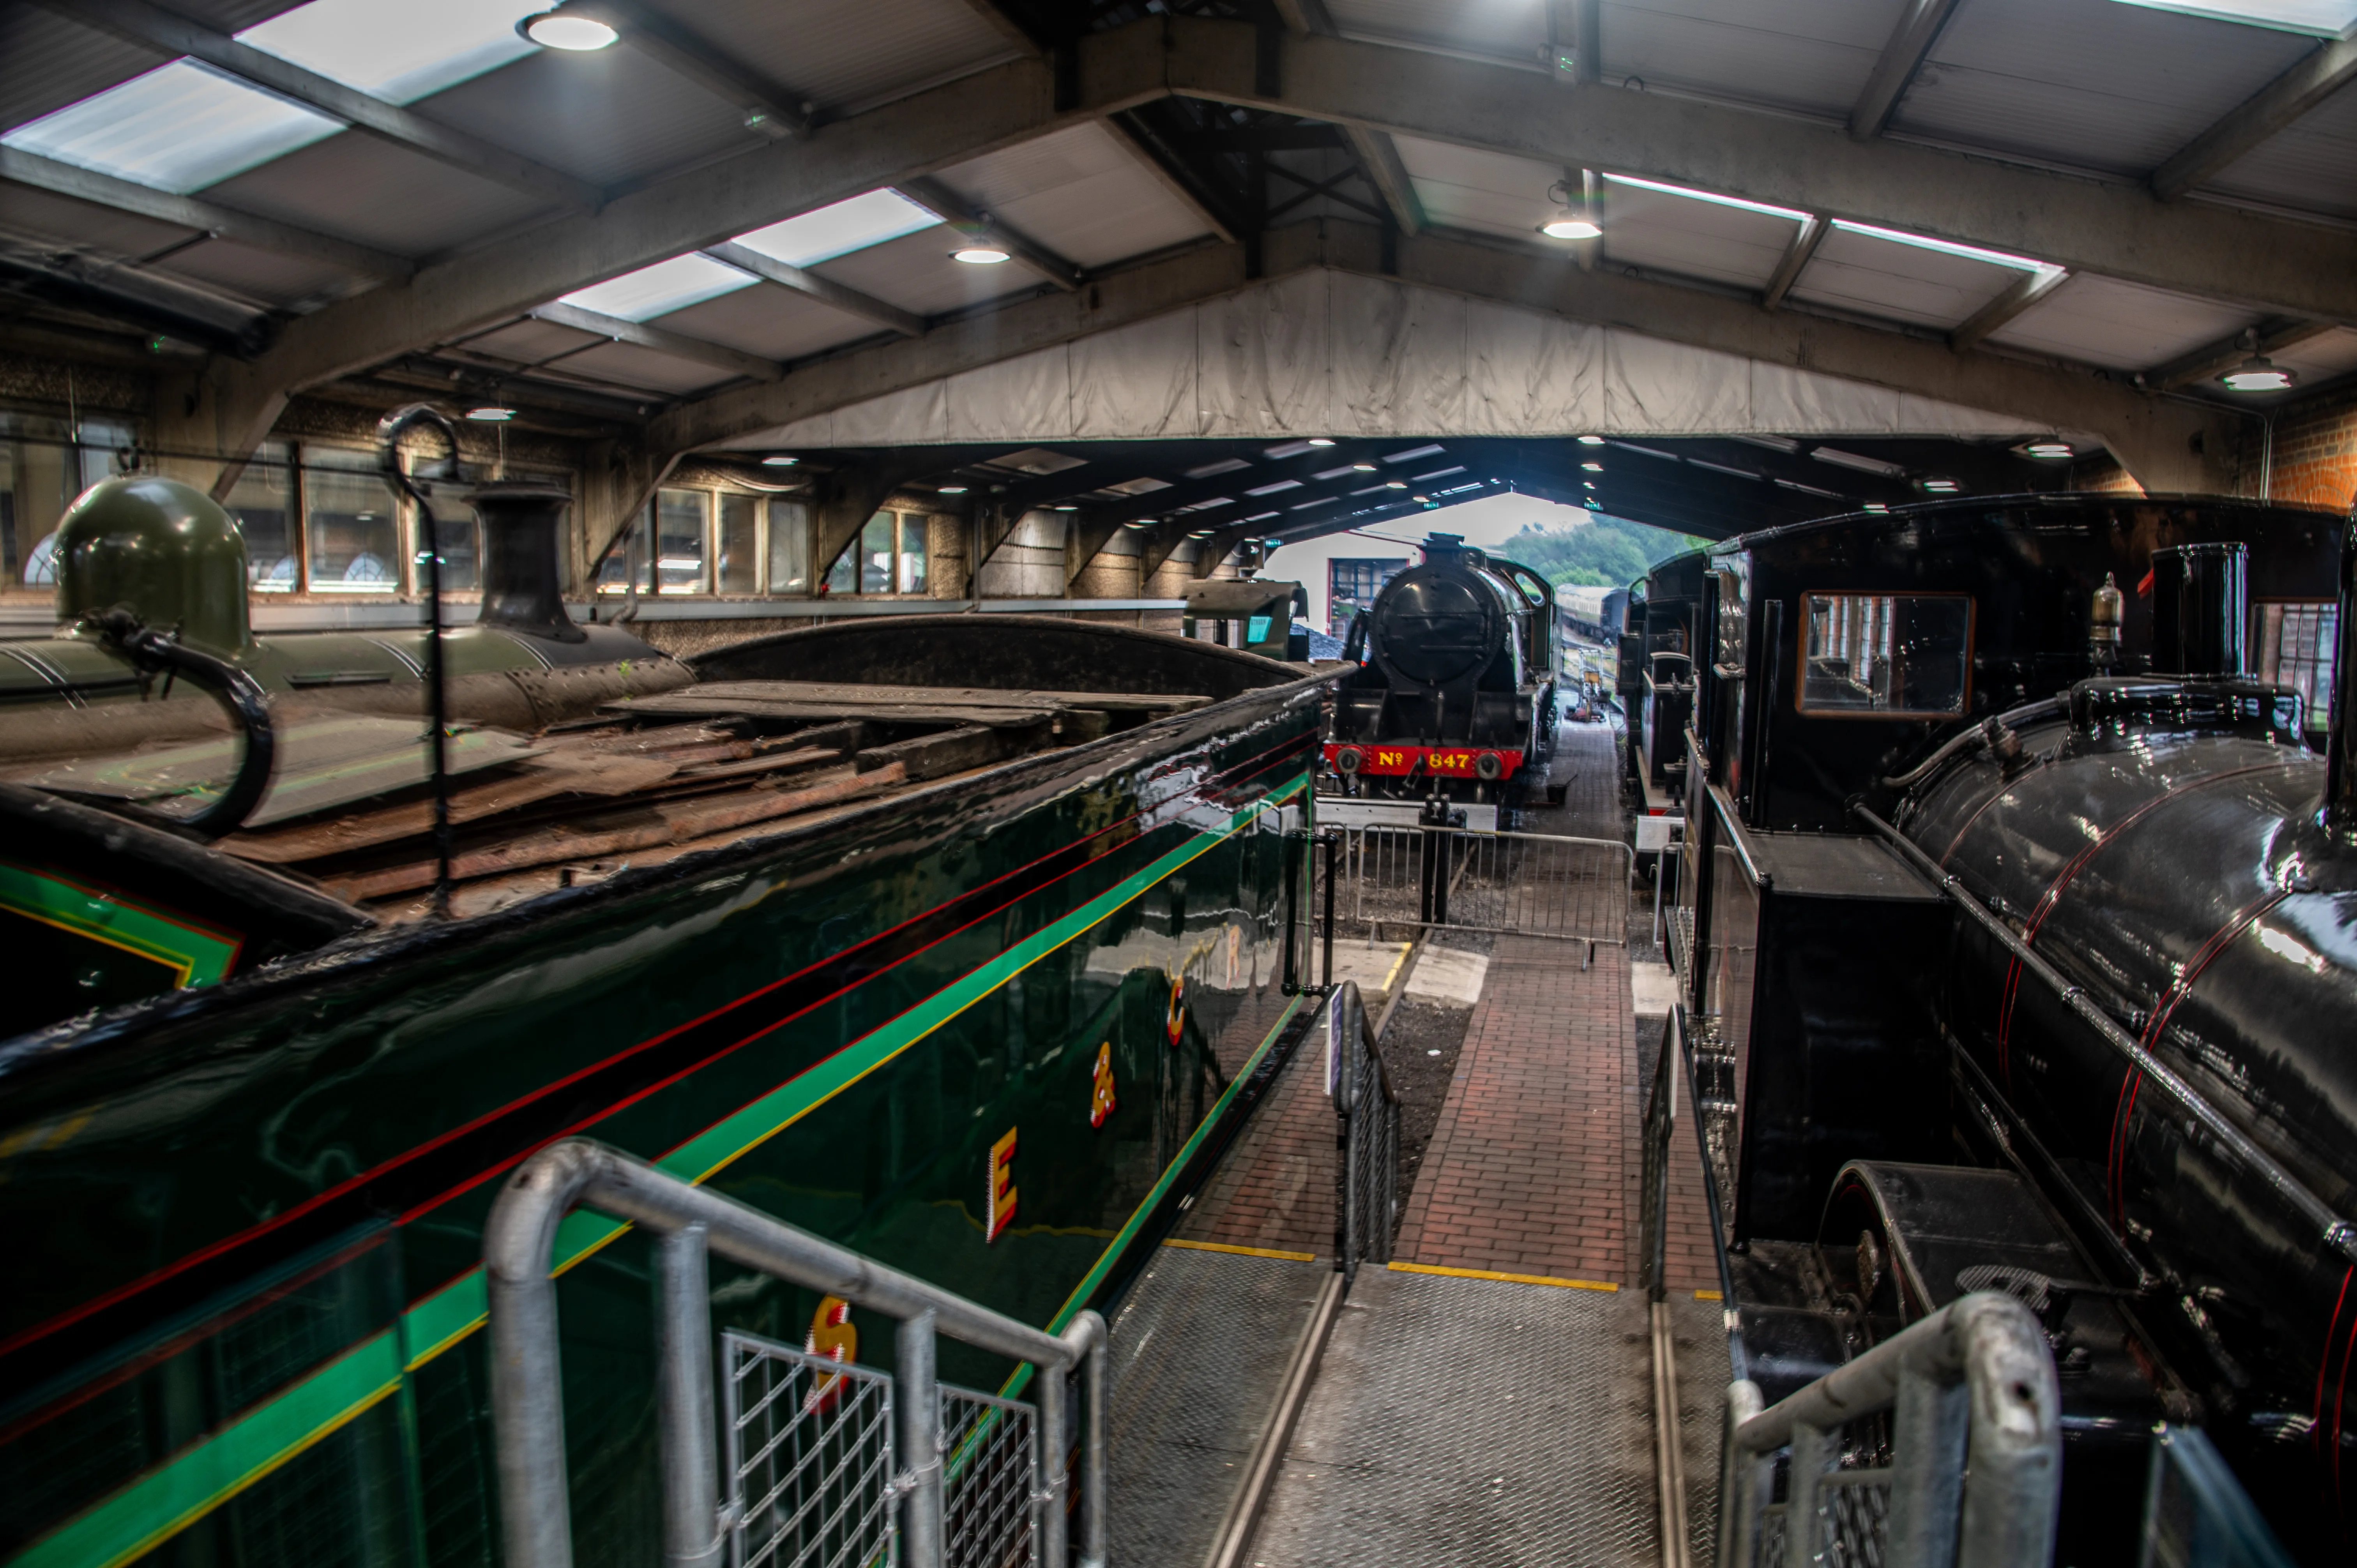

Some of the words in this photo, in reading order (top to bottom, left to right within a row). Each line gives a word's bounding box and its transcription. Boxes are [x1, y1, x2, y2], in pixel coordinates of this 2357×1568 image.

[1429, 753, 1470, 769] 847
[802, 1292, 857, 1415] S
[986, 1125, 1018, 1244] E
[1090, 1041, 1116, 1128] &
[1167, 974, 1185, 1046] C
[1227, 924, 1240, 991] R
